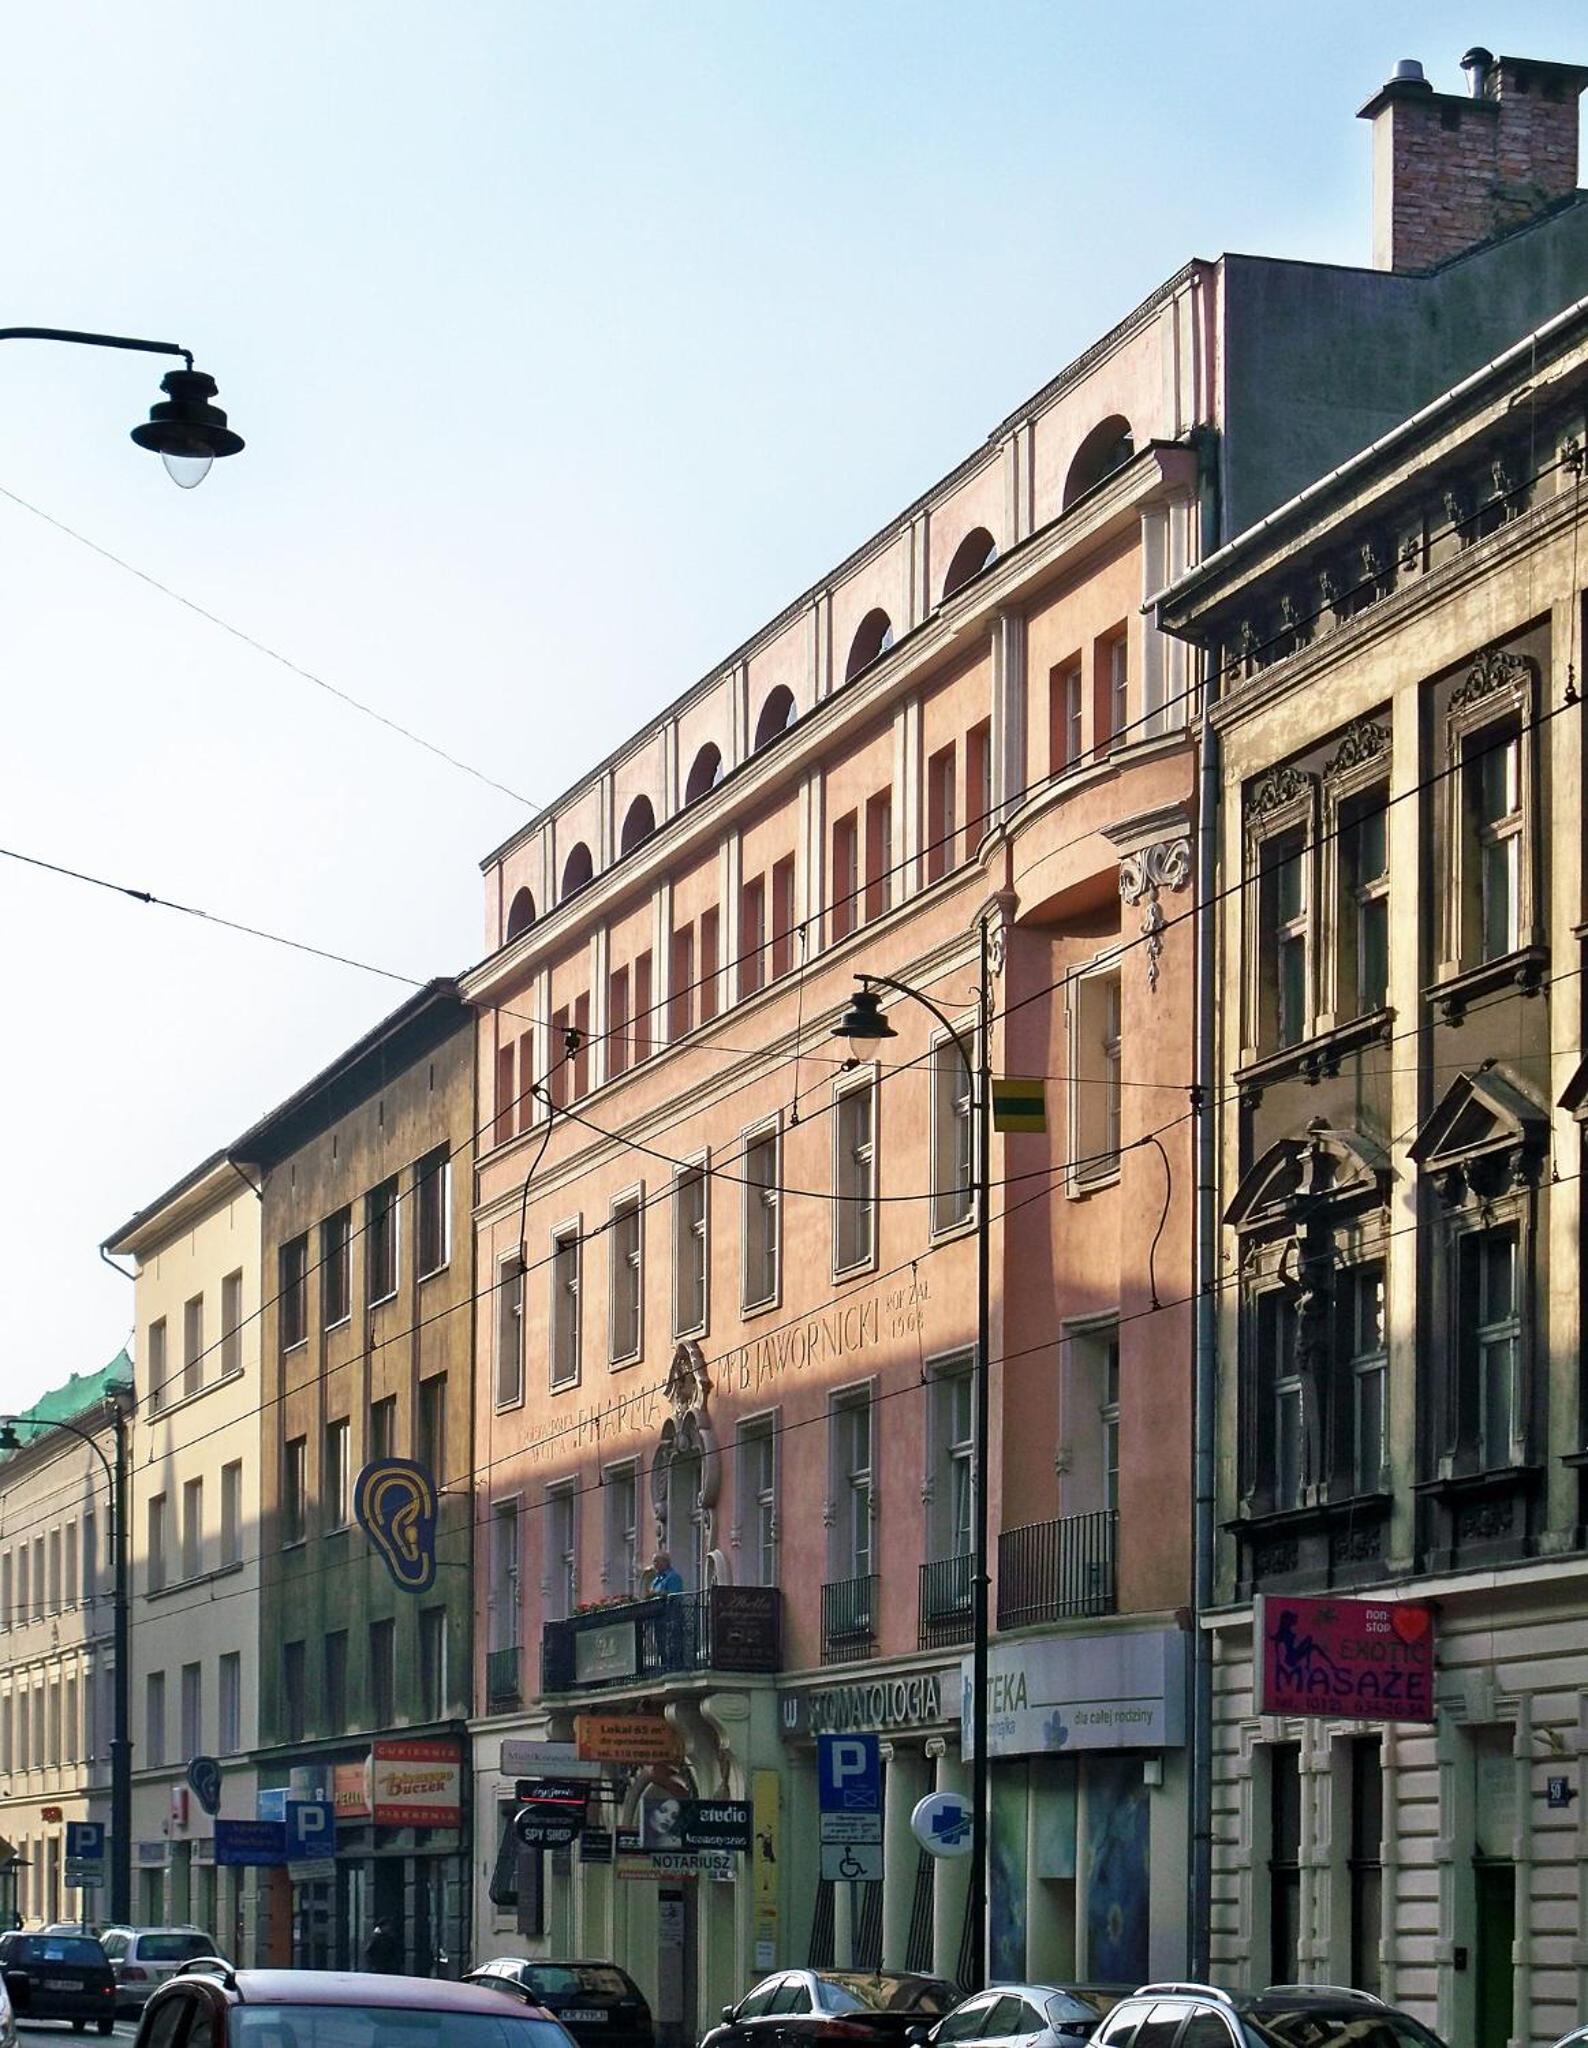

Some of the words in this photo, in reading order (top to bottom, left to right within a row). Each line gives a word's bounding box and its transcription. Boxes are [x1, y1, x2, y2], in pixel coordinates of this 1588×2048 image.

[756, 1297, 879, 1395] JAWORNICKI
[1365, 1621, 1391, 1633] stop
[1339, 1637, 1425, 1664] EXOTIC
[1274, 1663, 1425, 1701] MASAŻE
[808, 1674, 942, 1729] STOMATOLOGIA
[1074, 1710, 1088, 1725] dla
[1115, 1708, 1153, 1726] rodziny
[601, 1725, 632, 1735] Lokal
[377, 1746, 456, 1758] CUKIERNIA
[831, 1740, 867, 1789] P
[297, 1805, 326, 1842] P
[699, 1806, 747, 1823] studio
[75, 1825, 98, 1855] P
[524, 1828, 544, 1841] SPY
[546, 1828, 572, 1842] SHOP
[652, 1855, 732, 1870] NOTARIUSZ
